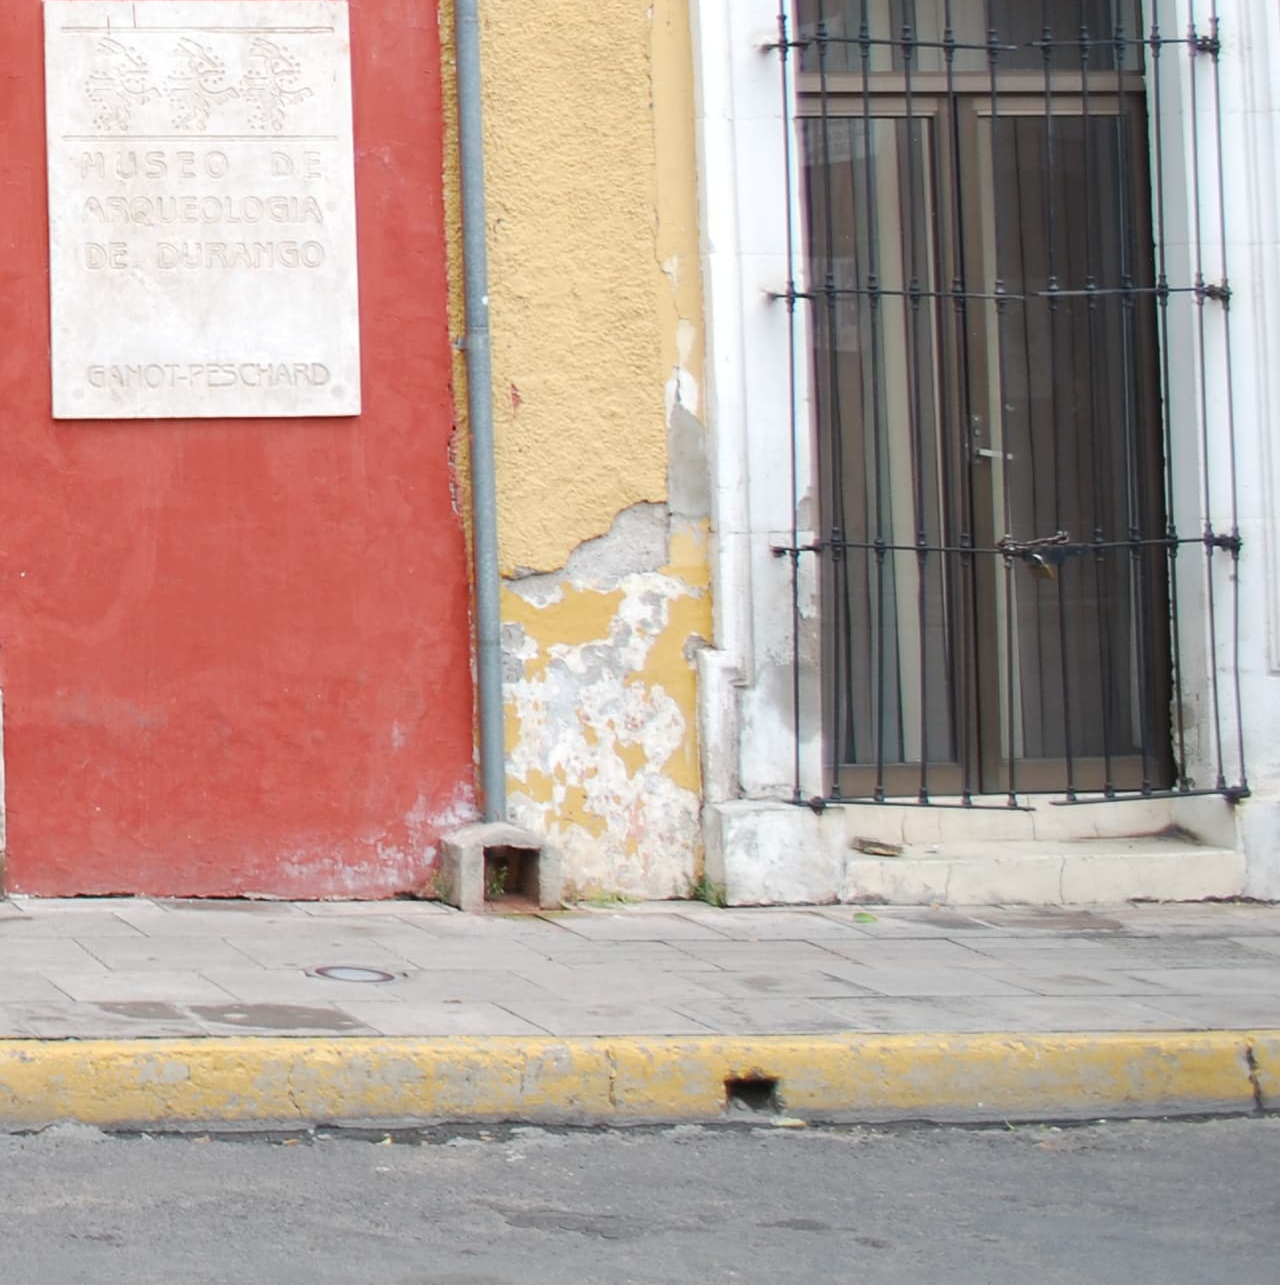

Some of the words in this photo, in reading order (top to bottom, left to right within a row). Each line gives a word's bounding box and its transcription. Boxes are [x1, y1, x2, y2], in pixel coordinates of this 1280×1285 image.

[80, 150, 230, 180] MUSEO
[271, 150, 322, 180] DE
[82, 195, 324, 226] ARQUEOLOGIA
[84, 241, 128, 270] DE
[156, 240, 326, 270] DURANGO
[87, 362, 331, 389] GANOT-PESCHARD
